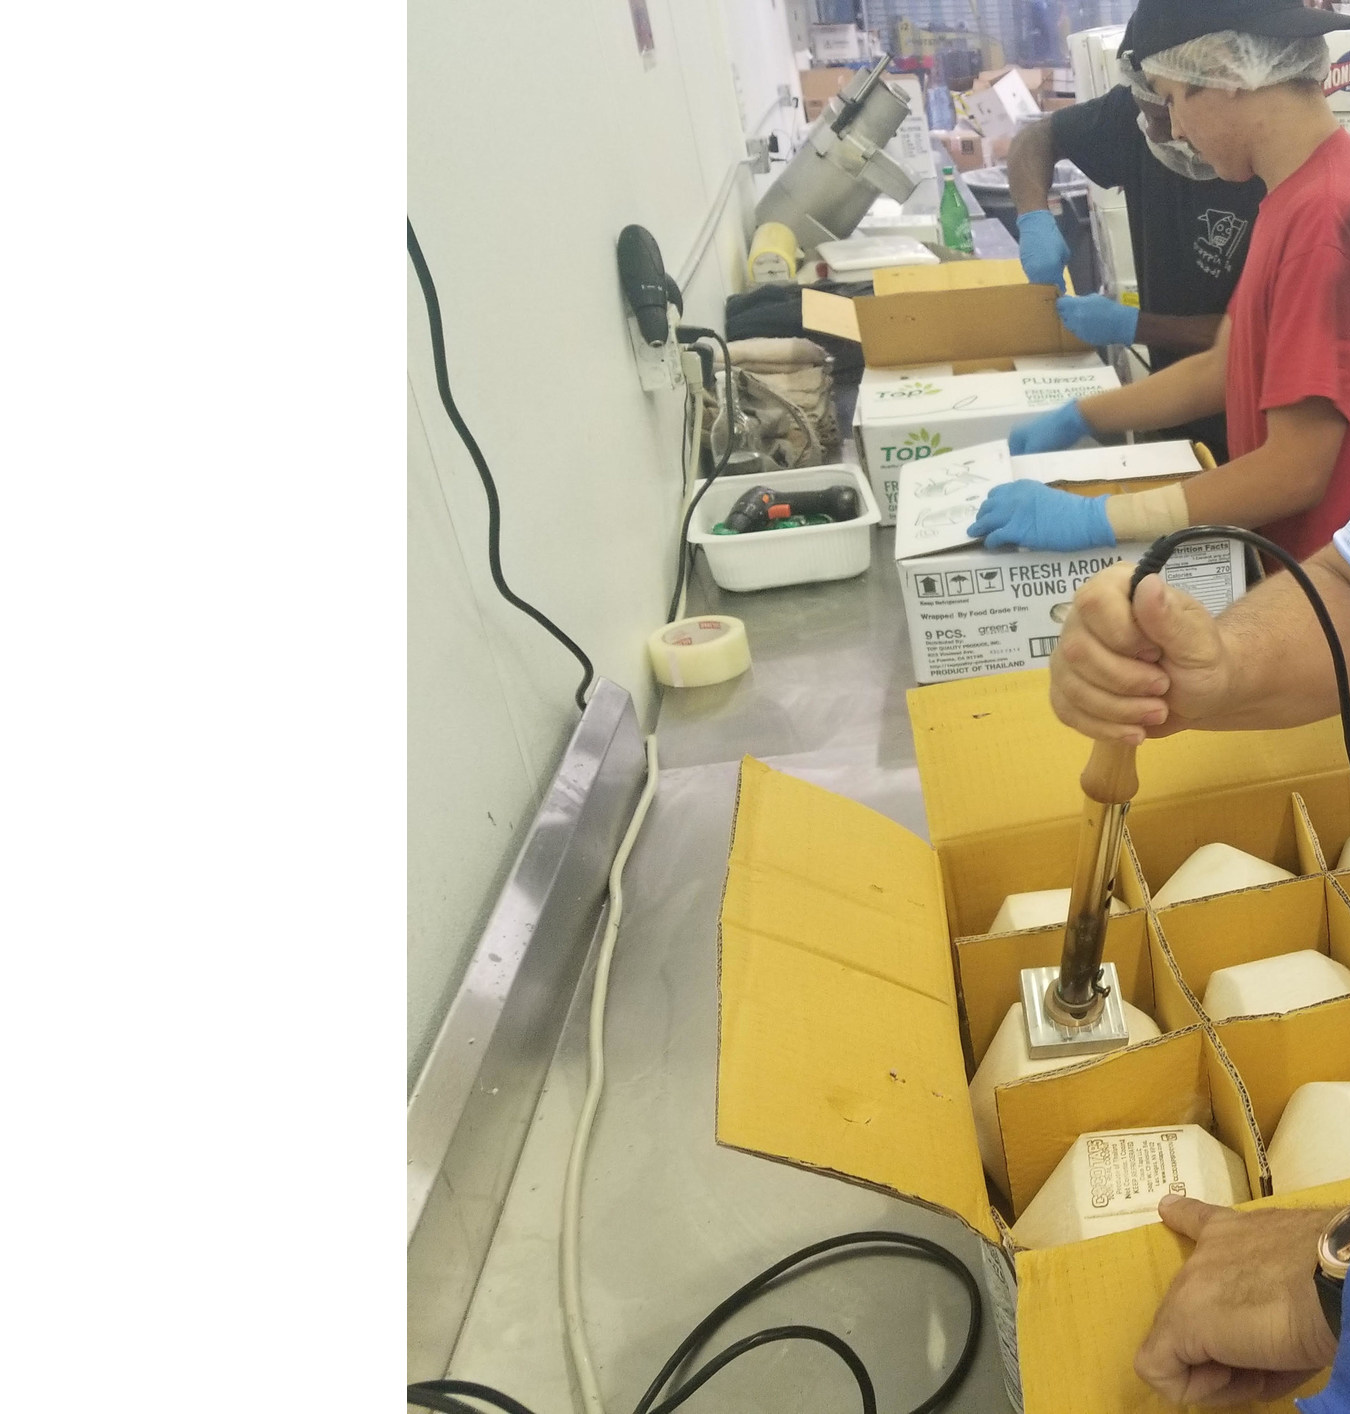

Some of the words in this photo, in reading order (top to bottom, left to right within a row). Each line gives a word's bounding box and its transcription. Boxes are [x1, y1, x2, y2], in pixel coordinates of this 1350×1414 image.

[1174, 545, 1203, 555] trition
[1205, 543, 1229, 552] Facts
[1009, 562, 1062, 582] FRESH
[1010, 578, 1067, 599] YOUNG
[921, 613, 954, 621] Wrapped
[969, 609, 987, 617] Food
[989, 607, 1011, 615] Grade
[925, 630, 933, 640] 9
[936, 629, 966, 639] PCS.
[978, 624, 1009, 636] green
[931, 667, 969, 676] PRODUCT
[985, 660, 1025, 671] THAILAND
[1131, 1179, 1139, 1194] KEEP
